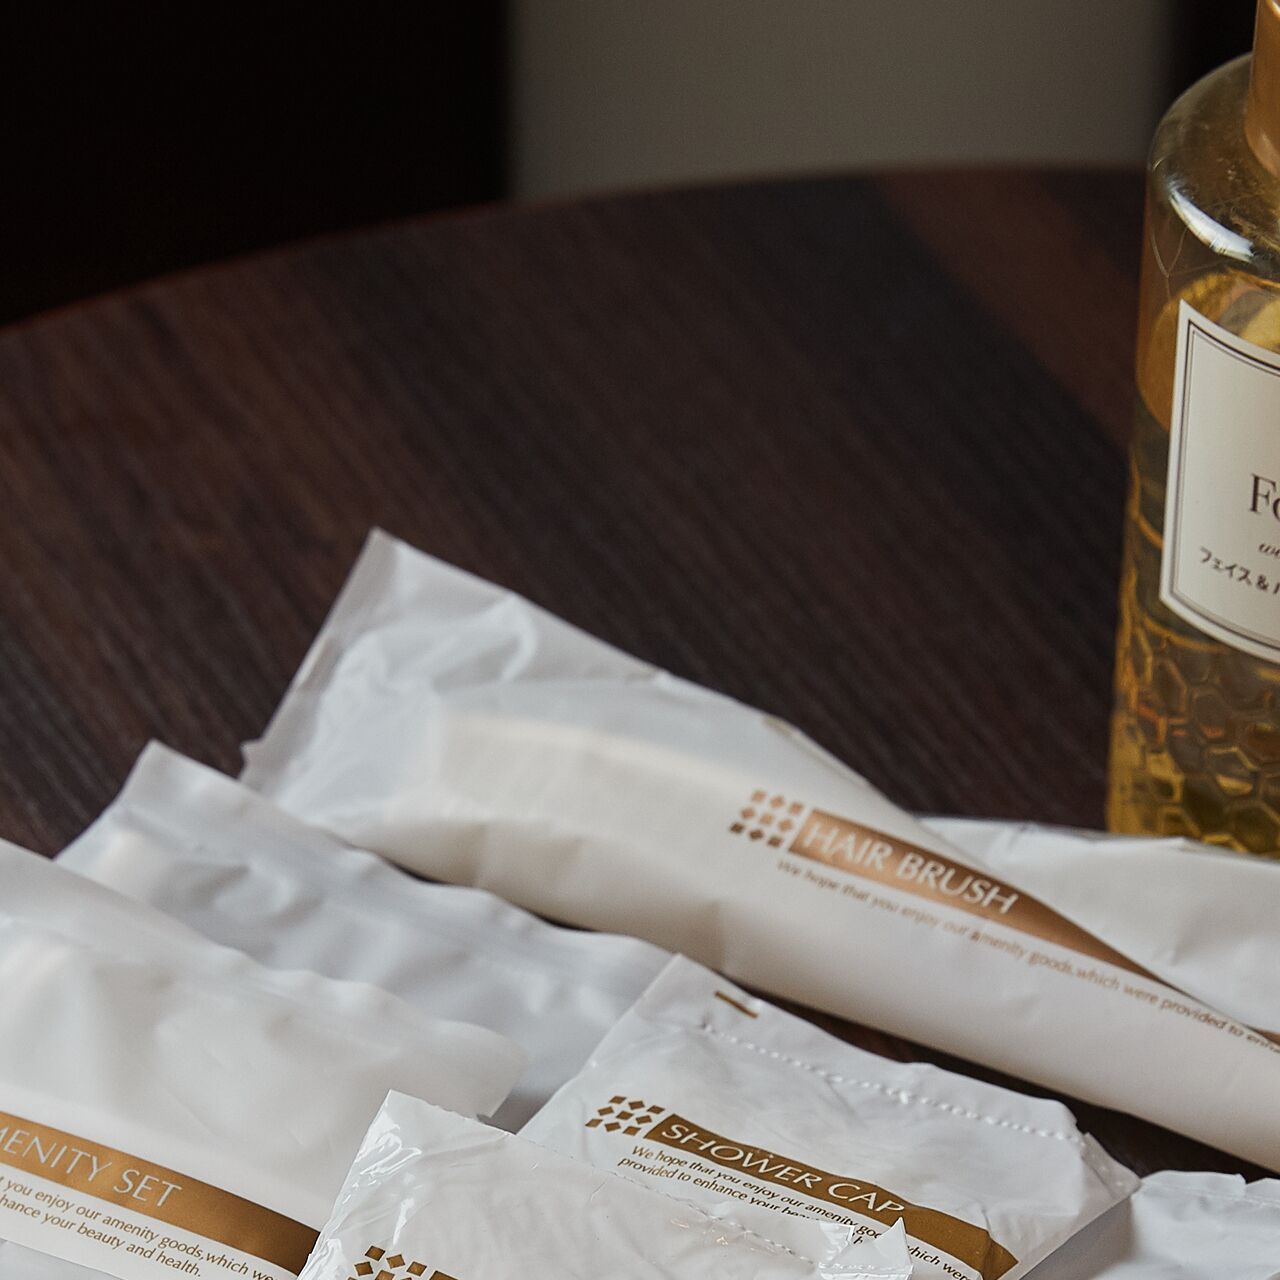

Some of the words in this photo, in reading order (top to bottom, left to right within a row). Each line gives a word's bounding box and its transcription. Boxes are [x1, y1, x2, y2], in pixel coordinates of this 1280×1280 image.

[802, 822, 894, 872] HAIR
[895, 851, 1020, 915] BRUSH
[113, 1168, 183, 1208] SET
[617, 1157, 679, 1179] provided
[677, 1172, 692, 1182] to
[693, 1178, 748, 1200] enhance
[631, 1145, 654, 1160] We
[655, 1151, 687, 1169] hope
[689, 1162, 715, 1176] that
[714, 1171, 741, 1184] you
[742, 1181, 780, 1200] enjoy
[781, 1195, 808, 1207] our
[805, 1204, 858, 1227] amenity
[661, 1123, 823, 1189] SHOWER
[827, 1182, 905, 1213] CAP
[5, 1179, 32, 1196] you
[34, 1191, 75, 1212] enjoy
[75, 1205, 102, 1221] our
[102, 1215, 159, 1243] amenity
[43, 1212, 76, 1231] your
[76, 1221, 125, 1249] beauty
[126, 1243, 156, 1260] and
[155, 1251, 201, 1278] health.
